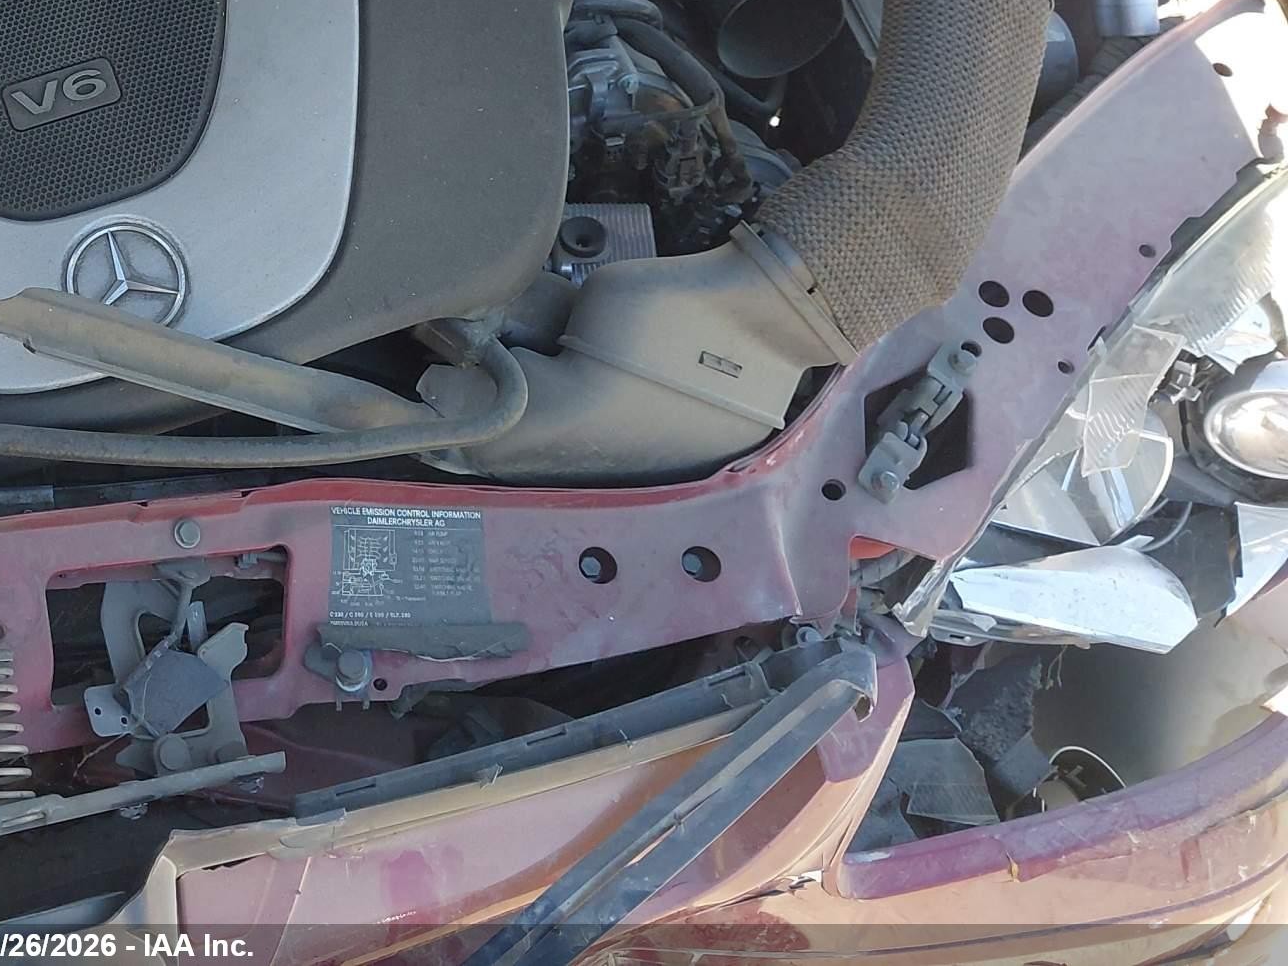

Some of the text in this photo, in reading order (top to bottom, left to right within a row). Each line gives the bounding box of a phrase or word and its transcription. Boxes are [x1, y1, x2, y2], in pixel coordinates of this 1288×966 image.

[11, 69, 107, 114] V6
[331, 506, 481, 519] VEHICLE EMISSION CONTROL INFORMATION
[367, 517, 445, 527] DAIMLERCHRYSLER AG
